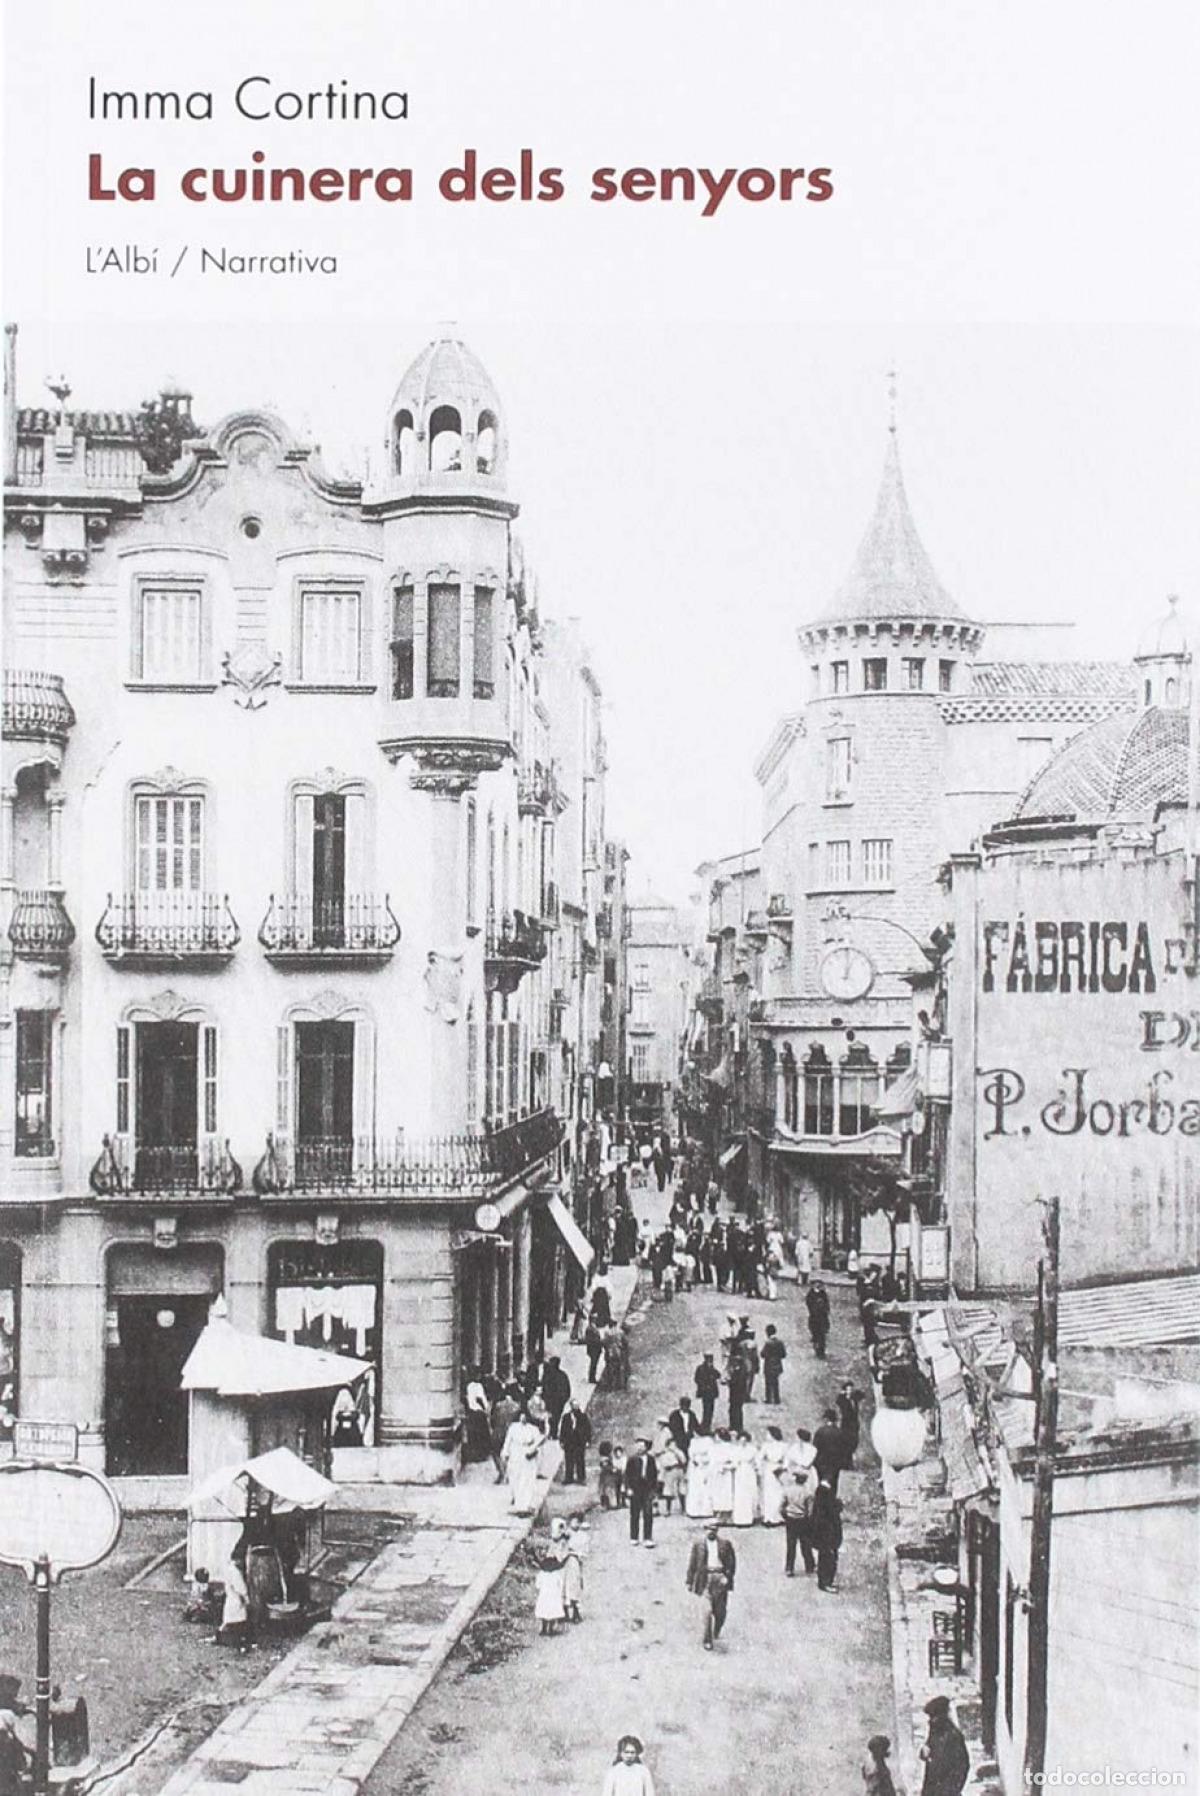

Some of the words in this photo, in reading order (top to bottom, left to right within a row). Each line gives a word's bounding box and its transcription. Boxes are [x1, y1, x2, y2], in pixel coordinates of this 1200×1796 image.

[89, 76, 213, 121] Imma
[235, 75, 409, 121] Cortina
[88, 153, 156, 202] La
[181, 150, 413, 203] cuinera
[439, 148, 565, 202] dels
[590, 167, 834, 217] senyors
[86, 244, 159, 274] L'Albí
[201, 247, 337, 275] Narrativa
[982, 912, 1157, 993] FÁBRICA
[975, 1067, 1032, 1141] P.
